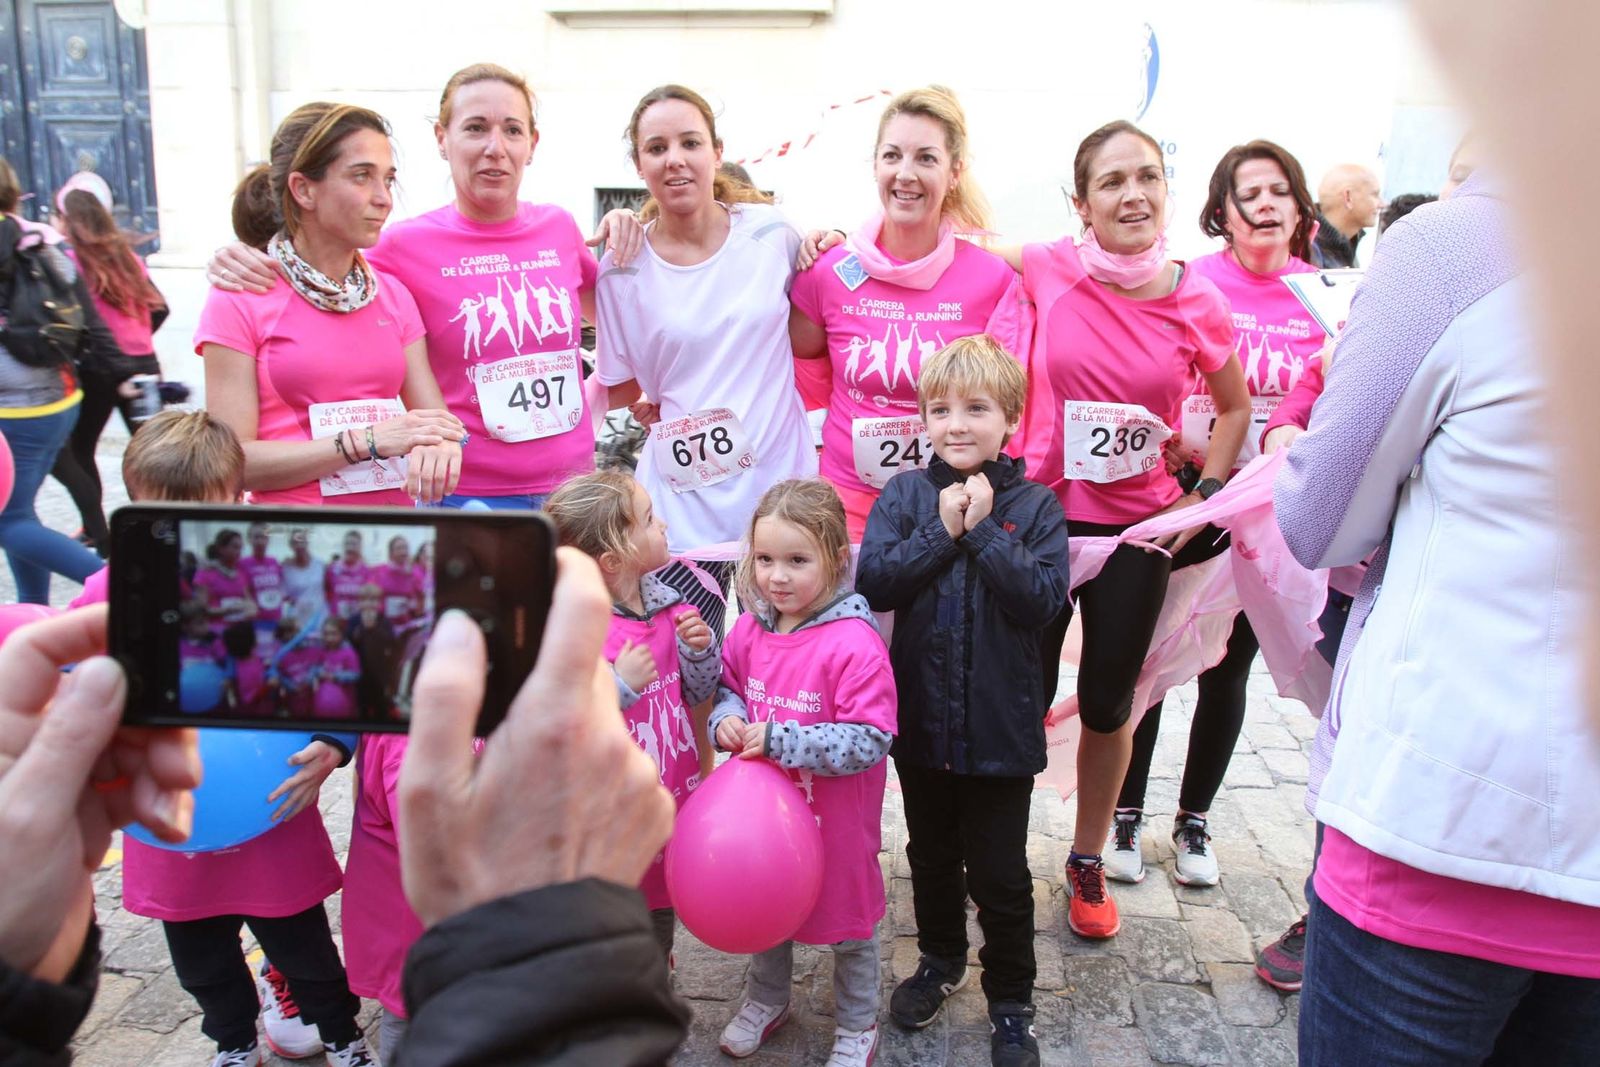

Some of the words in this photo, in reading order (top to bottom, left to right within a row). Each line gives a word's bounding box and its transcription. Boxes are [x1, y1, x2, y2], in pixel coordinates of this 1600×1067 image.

[460, 253, 509, 267] CARRERA
[537, 249, 558, 260] PINK
[441, 267, 457, 277] DE
[458, 265, 473, 276] LA
[475, 262, 512, 275] MUJER
[513, 263, 520, 271] &
[520, 257, 561, 270] RUNNING
[841, 305, 854, 315] DE
[855, 306, 868, 316] LA
[870, 308, 905, 320] MUJER
[907, 313, 913, 321] &
[915, 311, 963, 321] RUNNING
[860, 298, 905, 311] CARRERA
[938, 302, 962, 312] PINK
[1265, 324, 1311, 338] RUNNING
[1288, 318, 1310, 329] PINK
[496, 359, 536, 372] CARRERA
[557, 354, 574, 363] PINK
[481, 374, 494, 384] DE
[495, 371, 506, 381] LA
[508, 367, 538, 379] MUJER
[543, 361, 575, 374] RUNNING
[508, 375, 566, 412] 497
[337, 405, 377, 415] CARRERA
[1086, 406, 1126, 416] CARRERA
[1189, 406, 1200, 414] DE
[319, 417, 333, 426] DE
[335, 416, 348, 425] LA
[350, 413, 378, 423] MUJER
[656, 432, 664, 440] DE
[671, 424, 693, 435] MUJER
[699, 413, 733, 427] RUNNING
[874, 420, 911, 430] CARRERA
[1071, 413, 1082, 421] DE
[1083, 413, 1094, 422] LA
[1096, 414, 1126, 425] MUJER
[872, 429, 882, 437] LA
[884, 428, 912, 436] MUJER
[672, 426, 734, 467] 678
[1090, 426, 1151, 458] 236
[879, 437, 932, 467] 24
[766, 696, 772, 705] &
[773, 695, 822, 714] RUNNING
